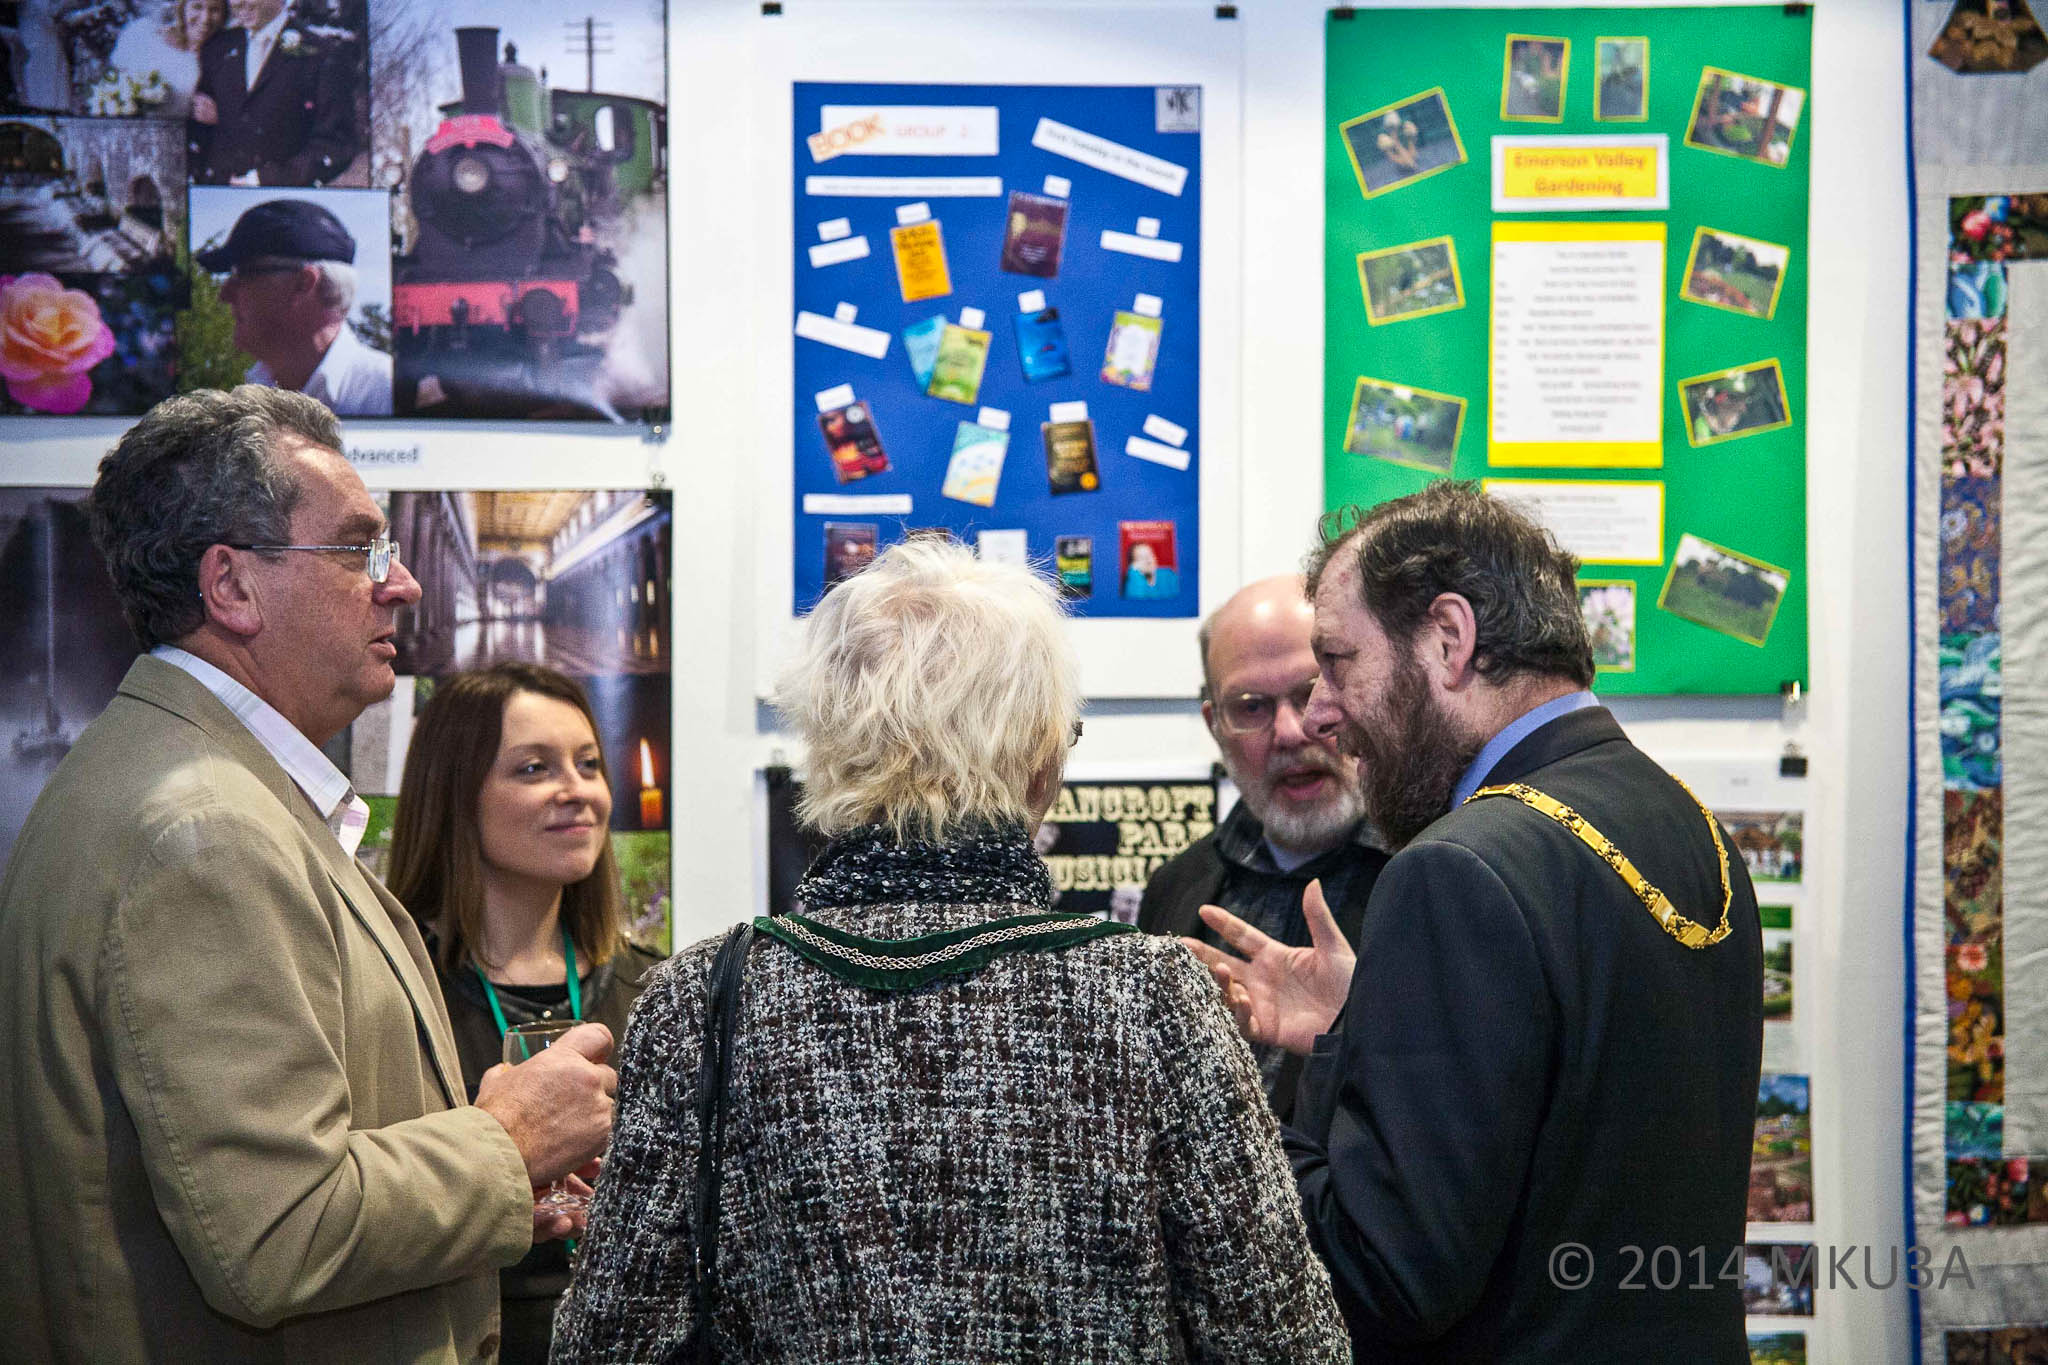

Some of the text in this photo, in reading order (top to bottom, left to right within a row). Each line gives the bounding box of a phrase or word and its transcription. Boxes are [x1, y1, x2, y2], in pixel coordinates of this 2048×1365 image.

[810, 113, 886, 156] BOOK
[1595, 152, 1646, 170] Valley
[1535, 176, 1625, 196] Gardening
[344, 445, 420, 464] dvanced
[1043, 785, 1214, 822] ANCROFT
